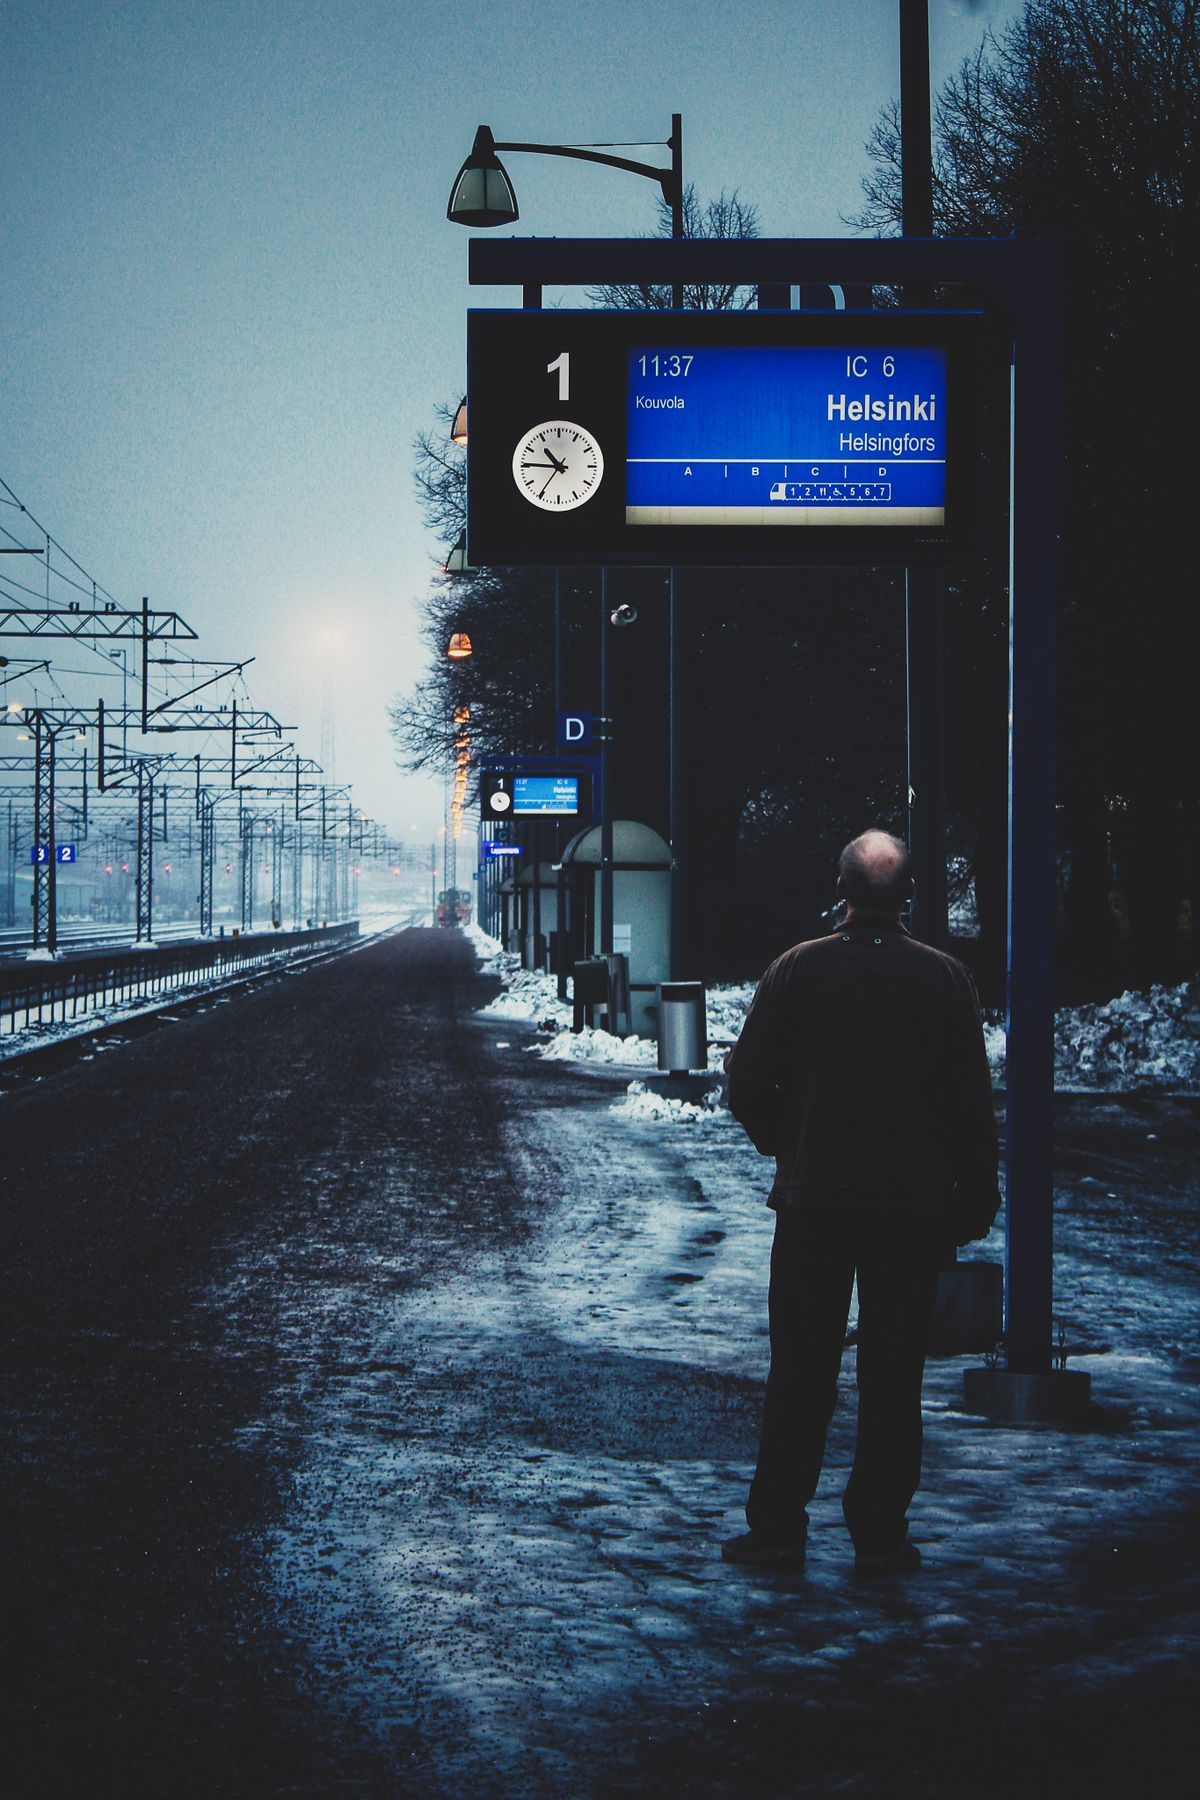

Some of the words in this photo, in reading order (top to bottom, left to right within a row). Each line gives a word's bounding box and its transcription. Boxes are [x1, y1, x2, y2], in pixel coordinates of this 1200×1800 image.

[547, 352, 570, 401] 1
[638, 355, 694, 377] 11:37
[846, 355, 869, 378] IC
[882, 355, 896, 378] 6
[635, 395, 685, 409] Kouvola
[826, 394, 937, 422] Helsinki
[839, 432, 936, 456] Helsingfors
[683, 466, 693, 477] A
[750, 466, 760, 477] B
[810, 466, 820, 477] C
[878, 466, 888, 477] D
[565, 718, 585, 741] D
[497, 778, 504, 790] 1
[61, 847, 71, 861] 2
